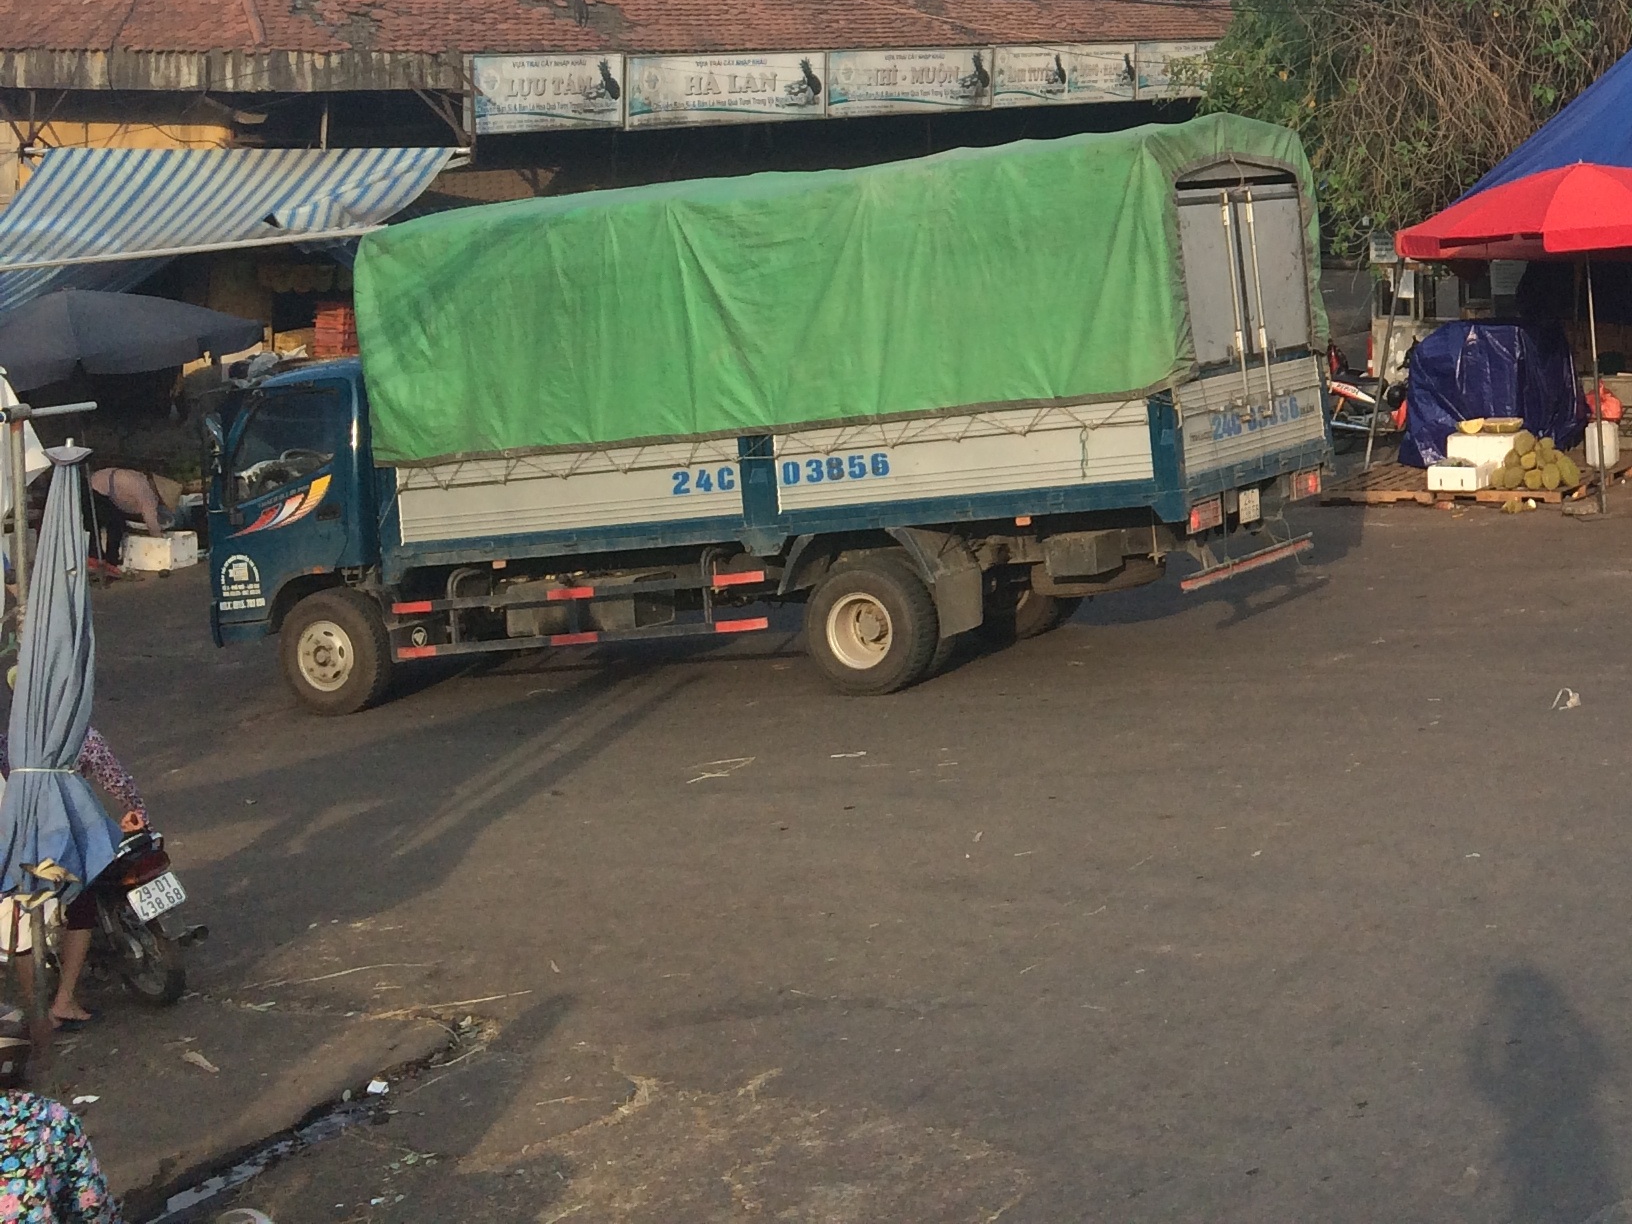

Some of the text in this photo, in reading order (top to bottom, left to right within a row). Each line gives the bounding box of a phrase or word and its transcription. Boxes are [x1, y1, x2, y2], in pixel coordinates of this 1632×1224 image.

[671, 452, 891, 496] 24C 03856
[135, 875, 172, 904] 29-01
